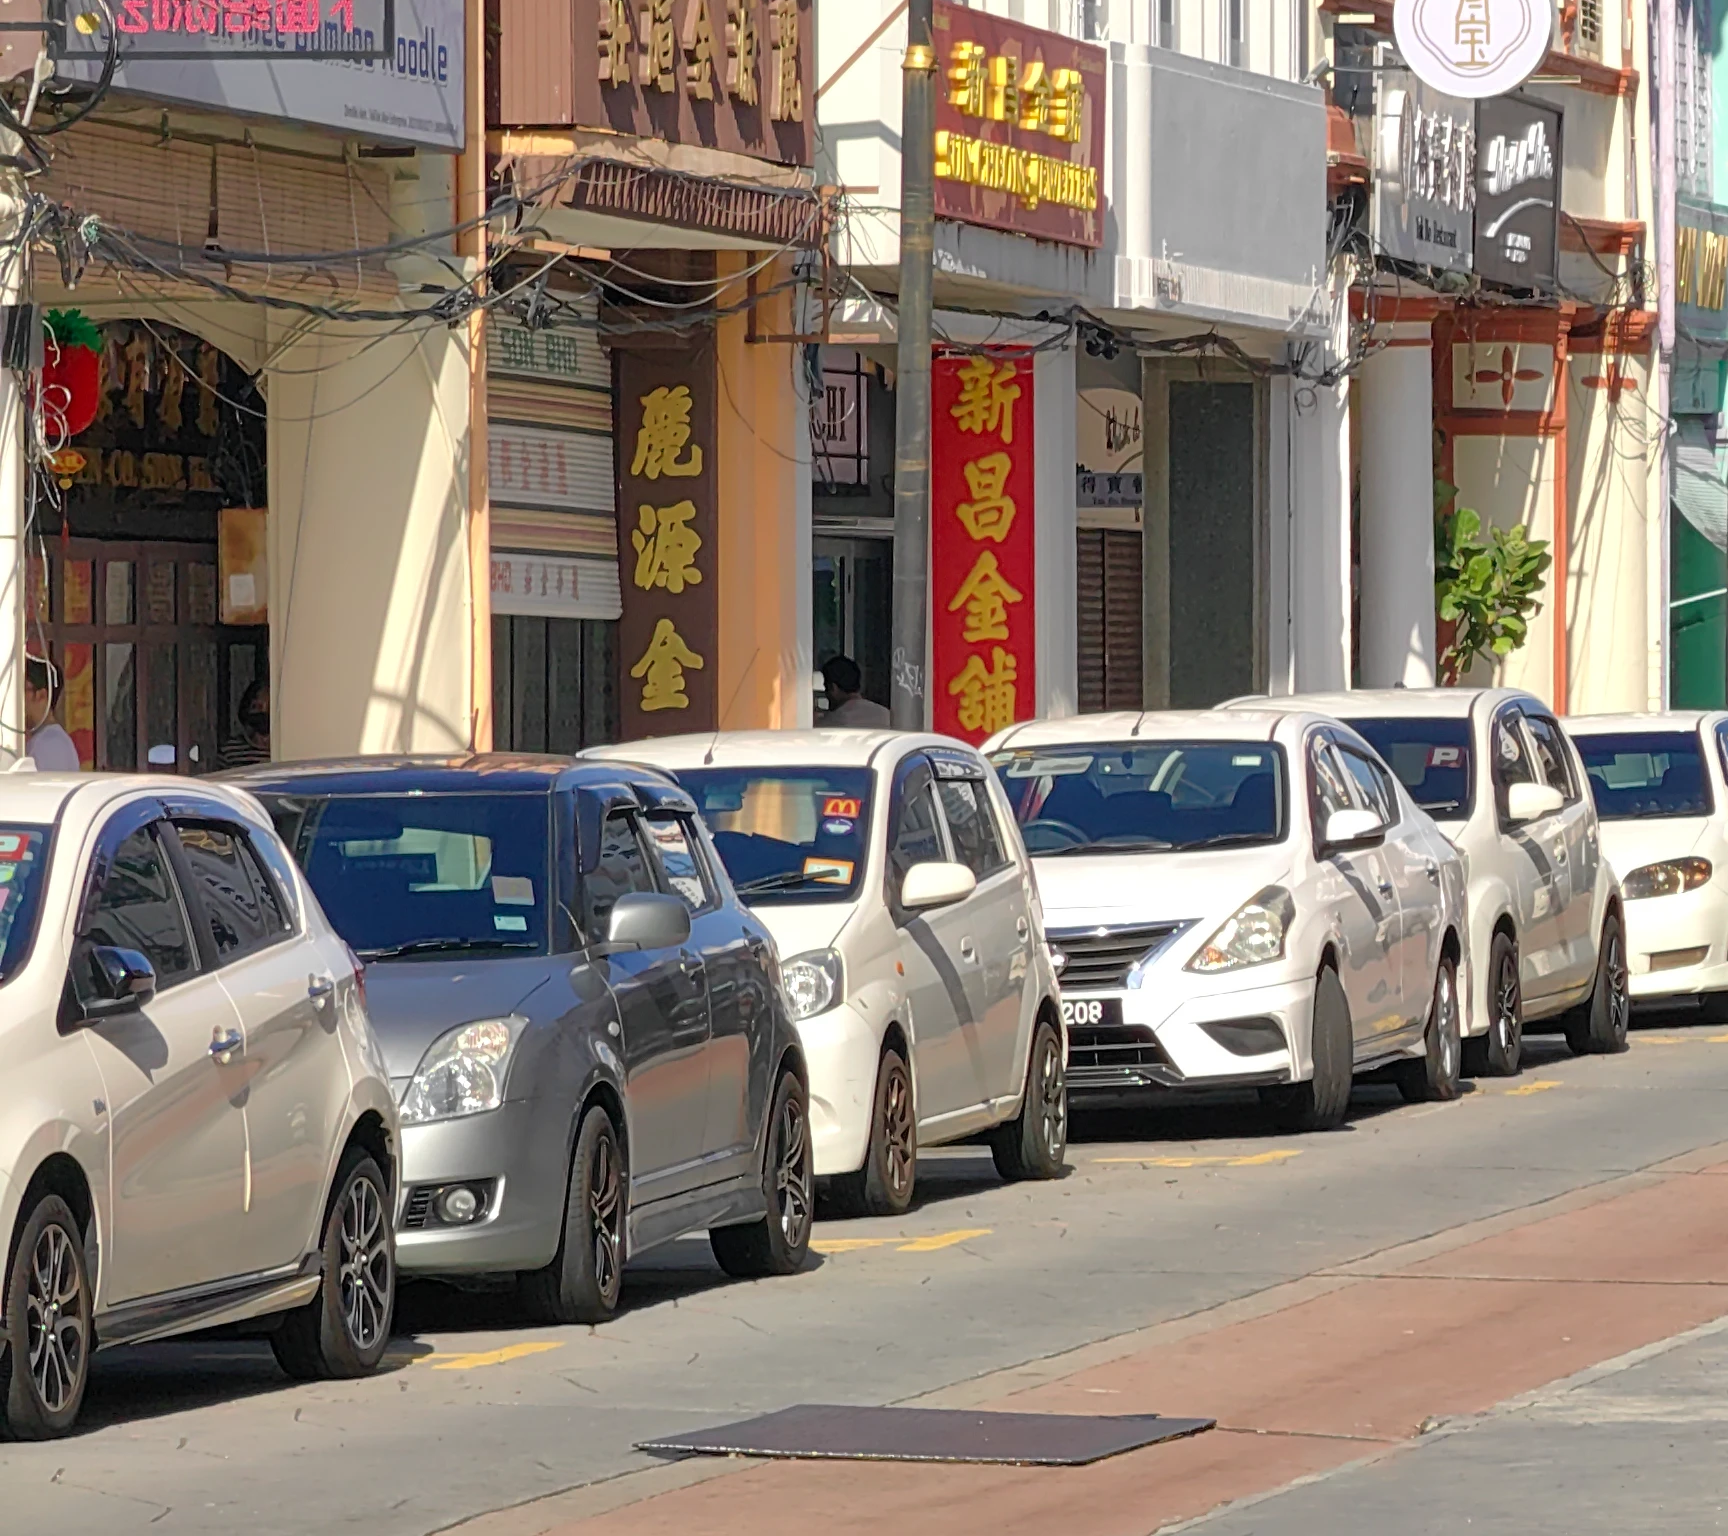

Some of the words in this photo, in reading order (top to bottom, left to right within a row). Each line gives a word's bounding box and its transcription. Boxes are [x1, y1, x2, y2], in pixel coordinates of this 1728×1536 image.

[630, 385, 704, 711] 麗源金
[1432, 747, 1460, 765] P
[1062, 1000, 1103, 1025] 208
